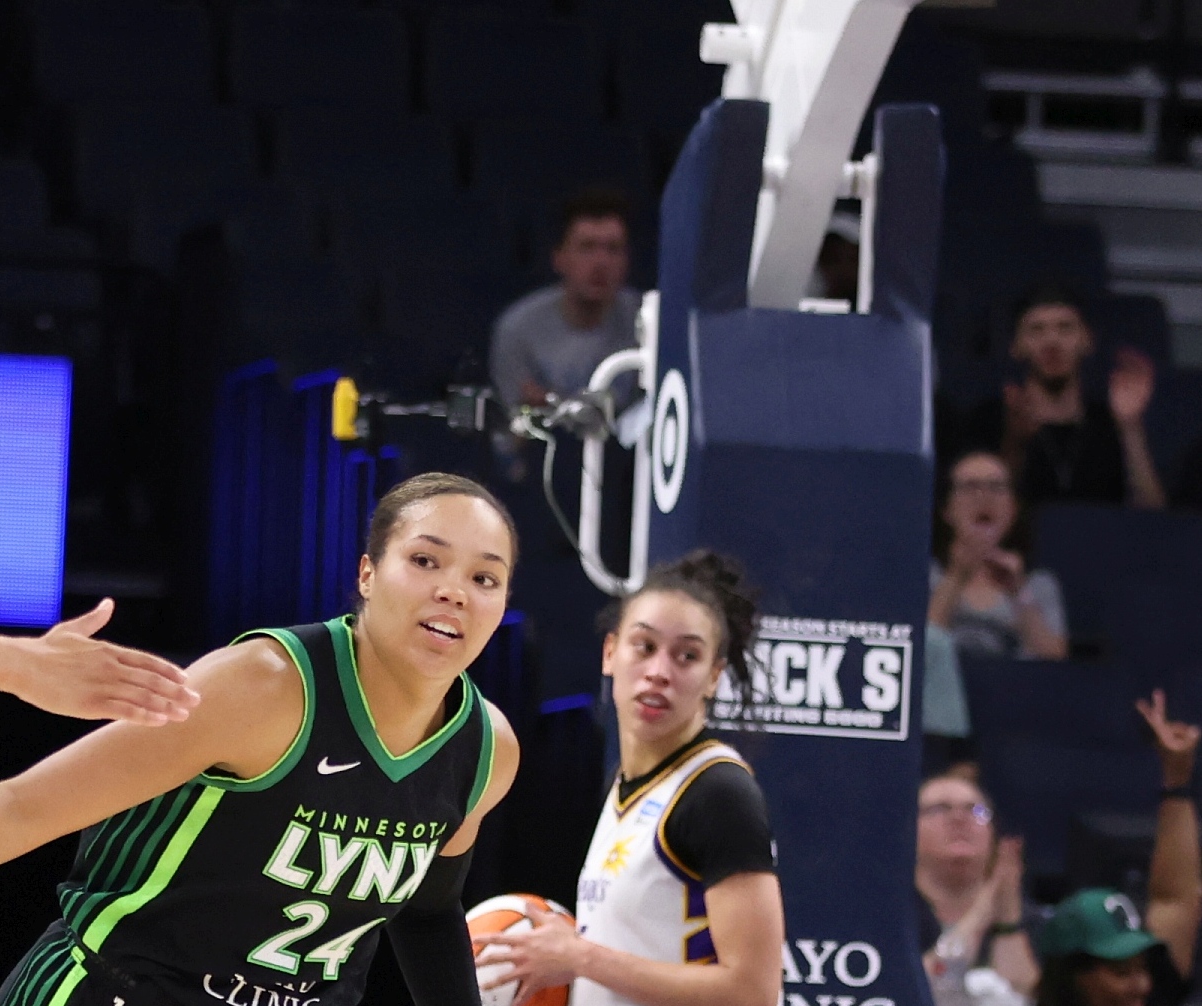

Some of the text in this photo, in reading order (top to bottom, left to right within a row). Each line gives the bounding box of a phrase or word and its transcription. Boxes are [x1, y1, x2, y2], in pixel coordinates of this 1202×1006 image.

[262, 820, 439, 904] LYNX
[247, 900, 387, 980] 24
[781, 939, 881, 987] AYO
